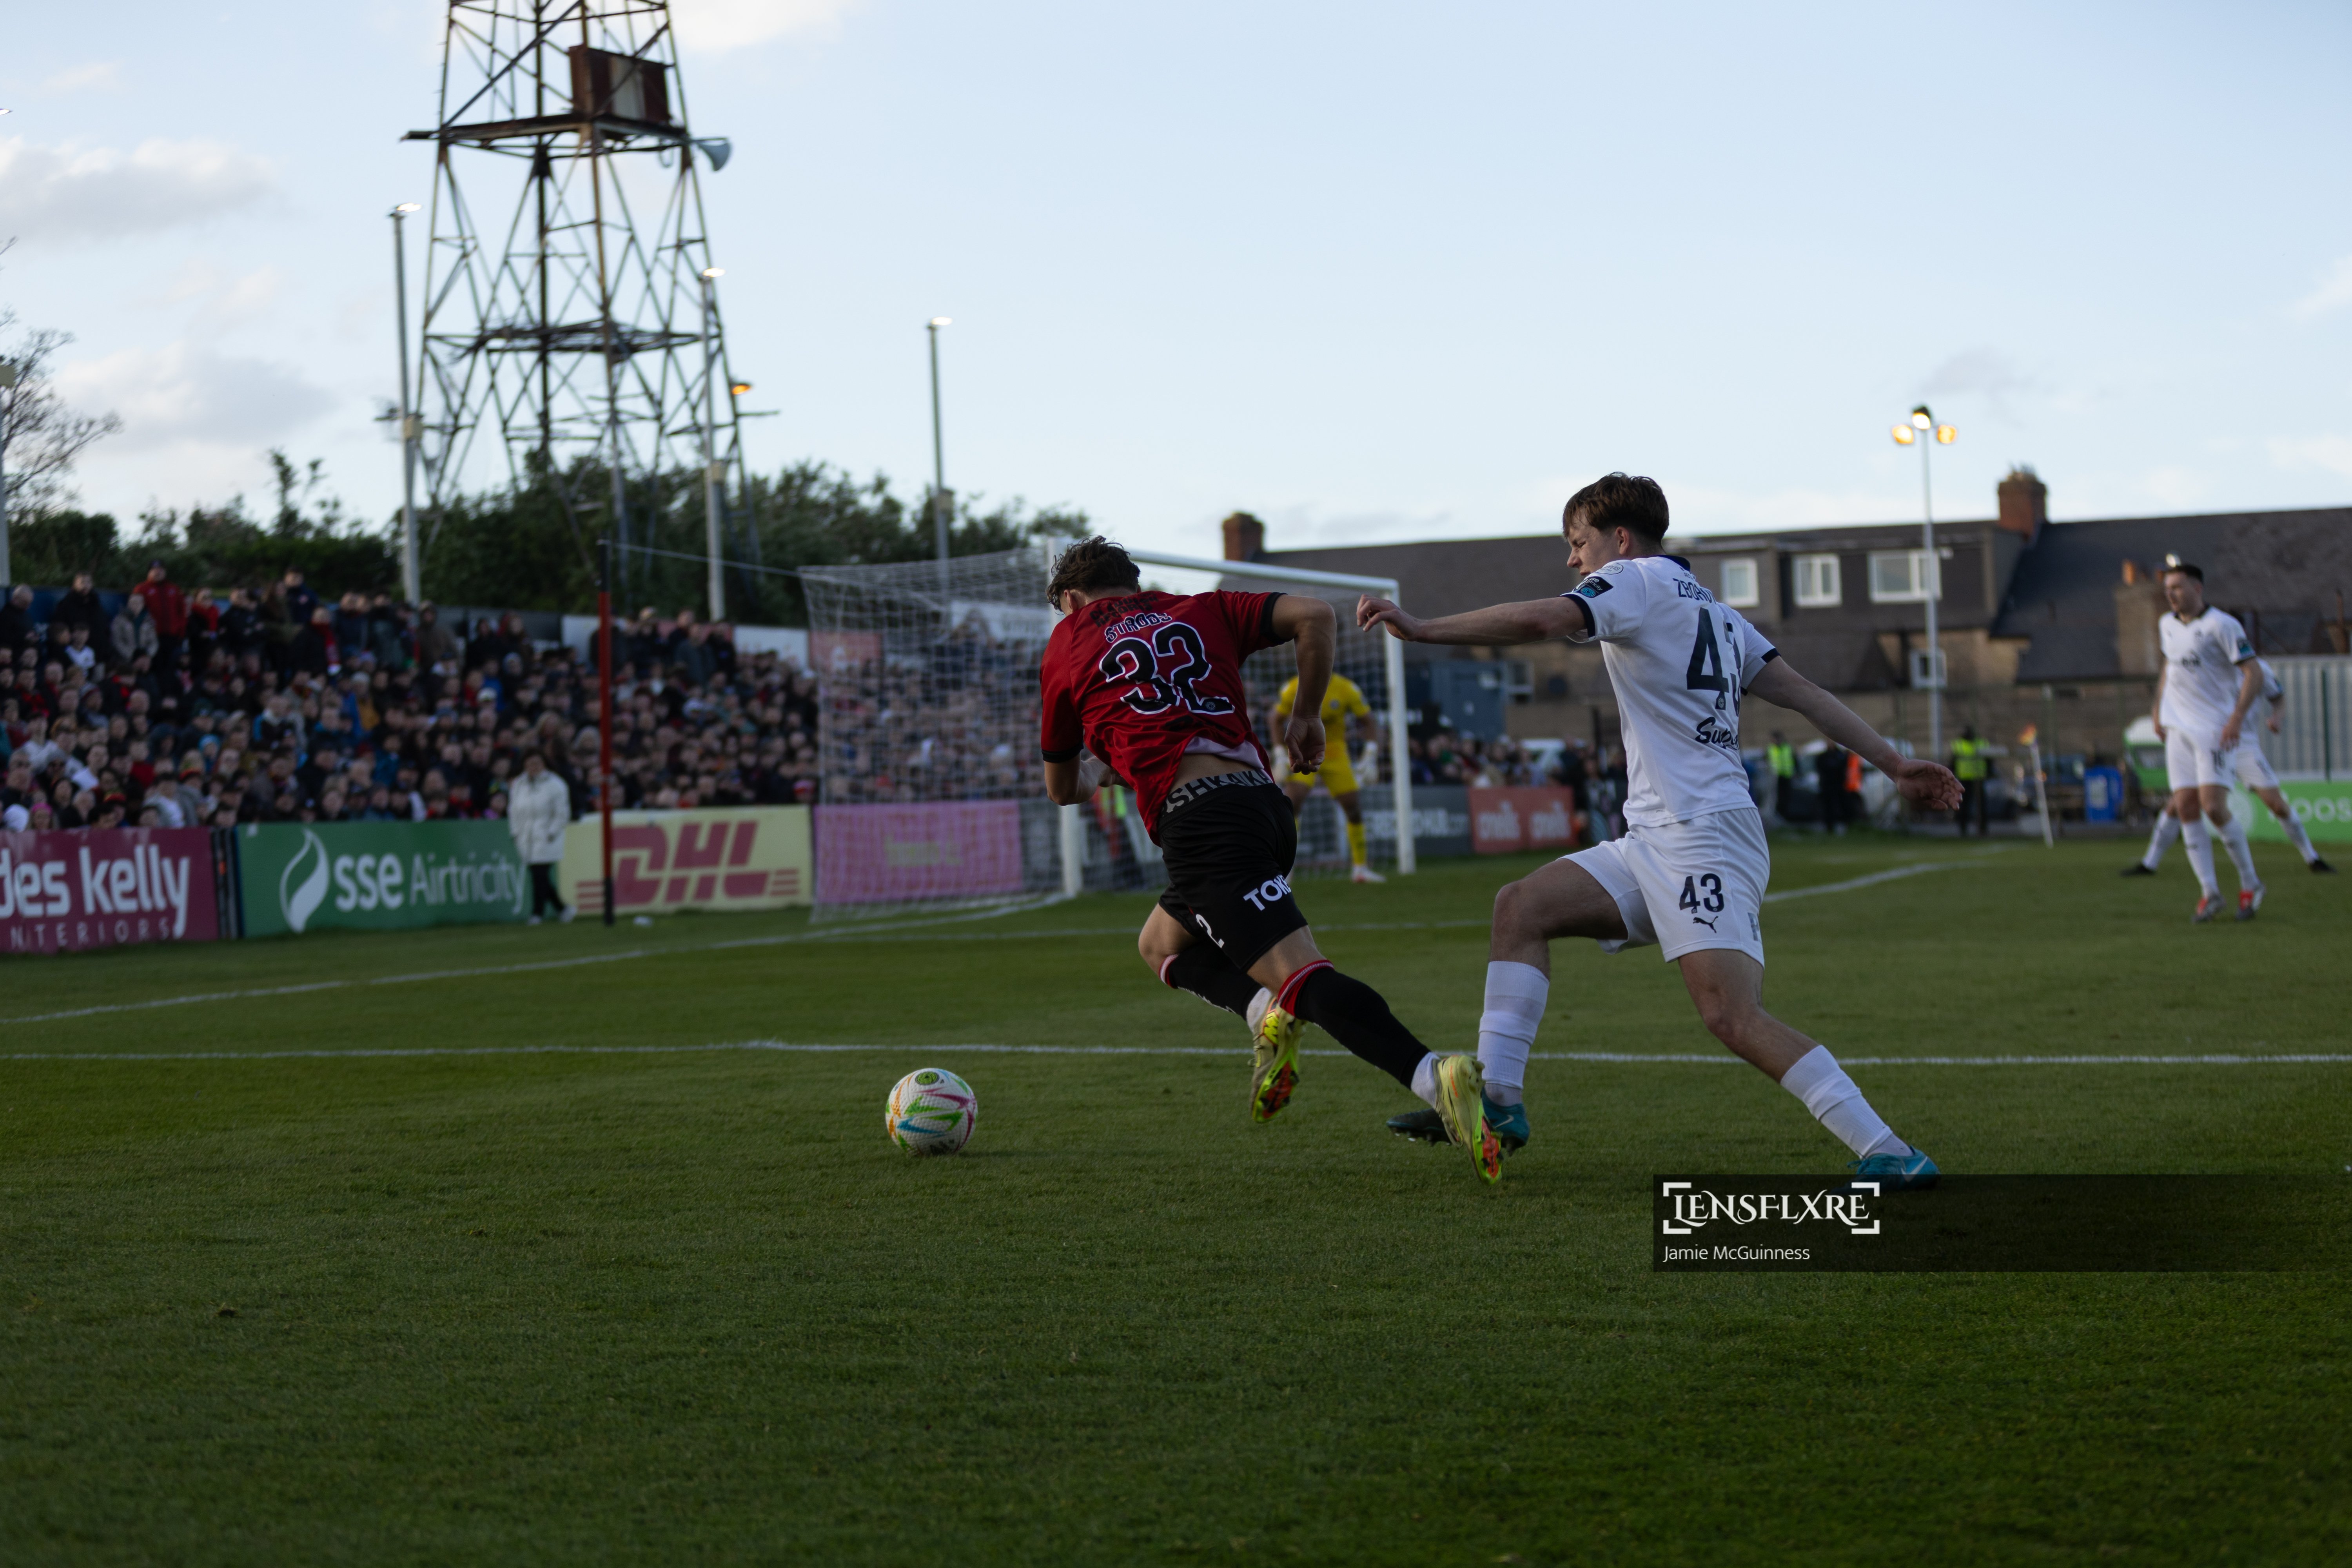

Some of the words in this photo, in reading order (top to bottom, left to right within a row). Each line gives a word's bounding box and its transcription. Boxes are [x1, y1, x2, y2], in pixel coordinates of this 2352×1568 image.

[1099, 622, 1235, 715] 32
[80, 844, 191, 938] kelly
[334, 854, 404, 912] sse
[410, 851, 527, 915] Airtricity
[609, 820, 771, 906] DHL
[1679, 873, 1724, 914] 43
